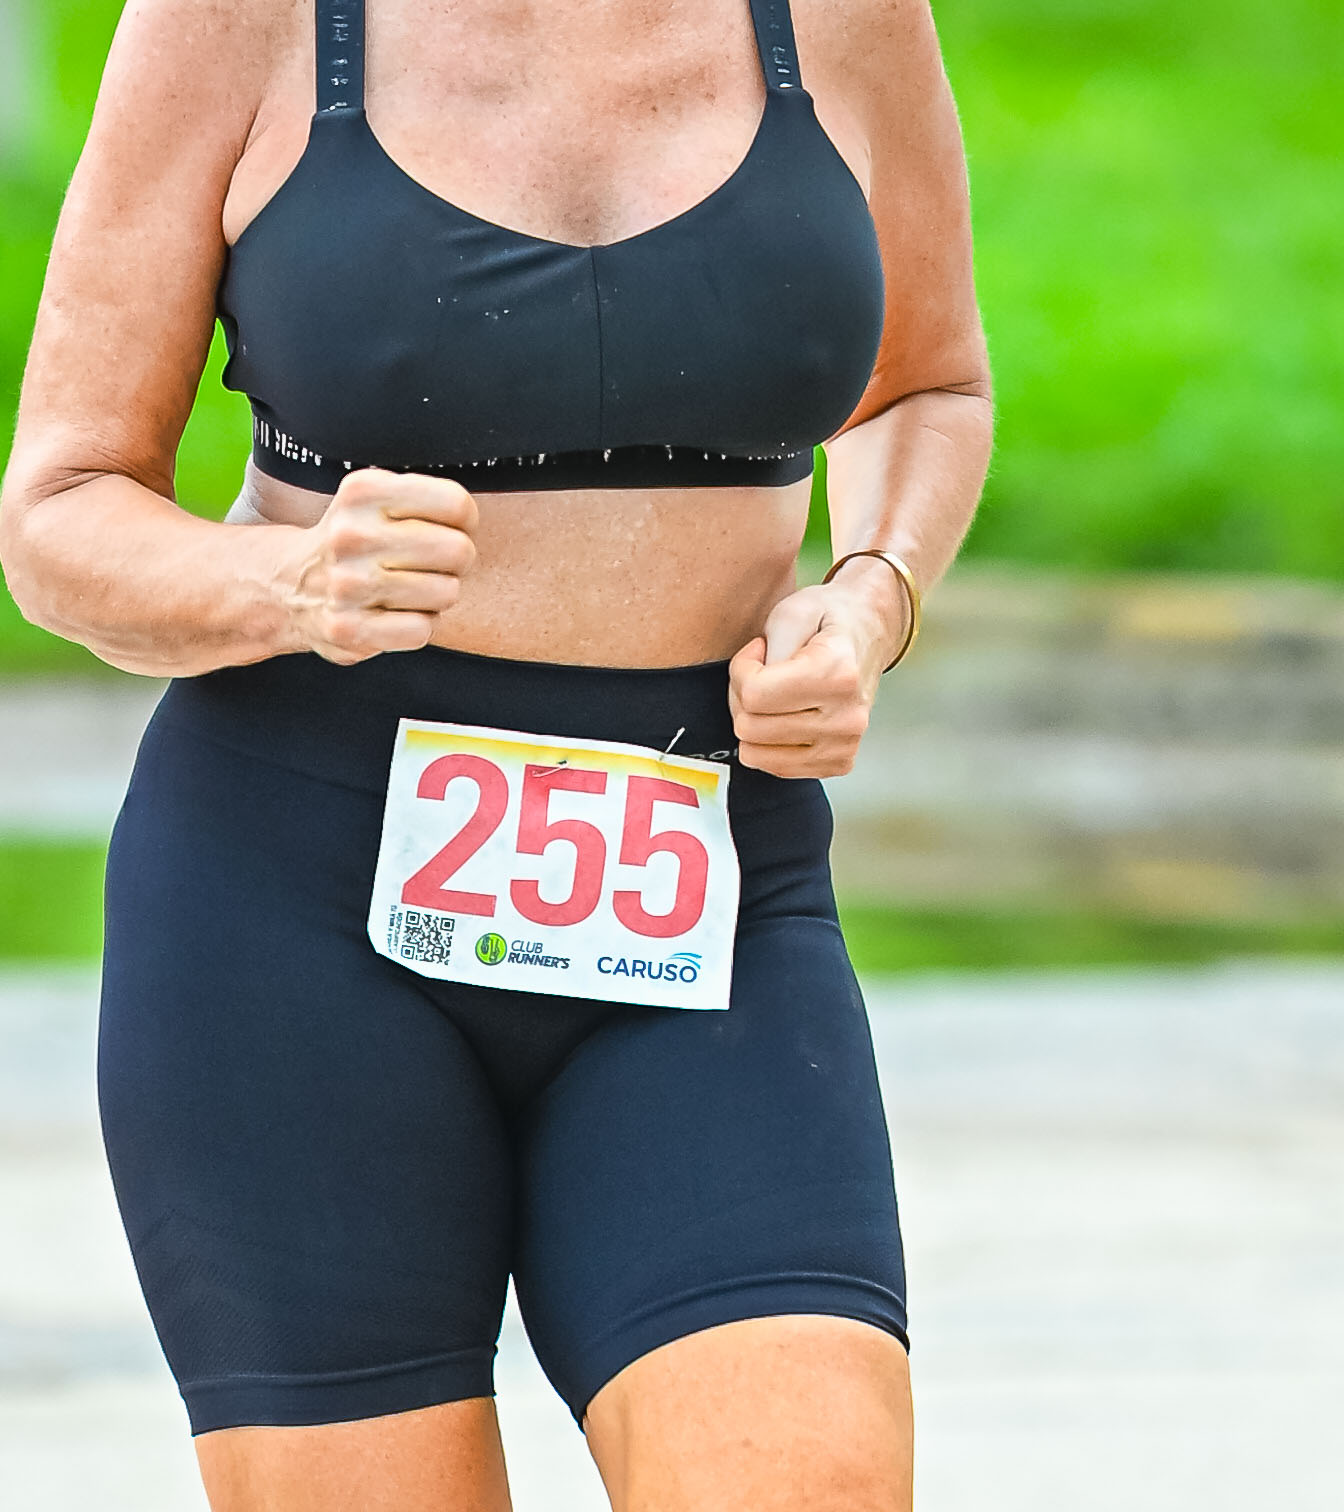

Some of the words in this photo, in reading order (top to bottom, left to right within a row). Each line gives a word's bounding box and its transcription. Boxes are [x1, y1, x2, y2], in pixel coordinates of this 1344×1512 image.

[401, 753, 709, 938] 255
[511, 939, 543, 954] CLUB
[507, 952, 571, 969] RUNNER'S
[597, 956, 698, 983] CARUSO
